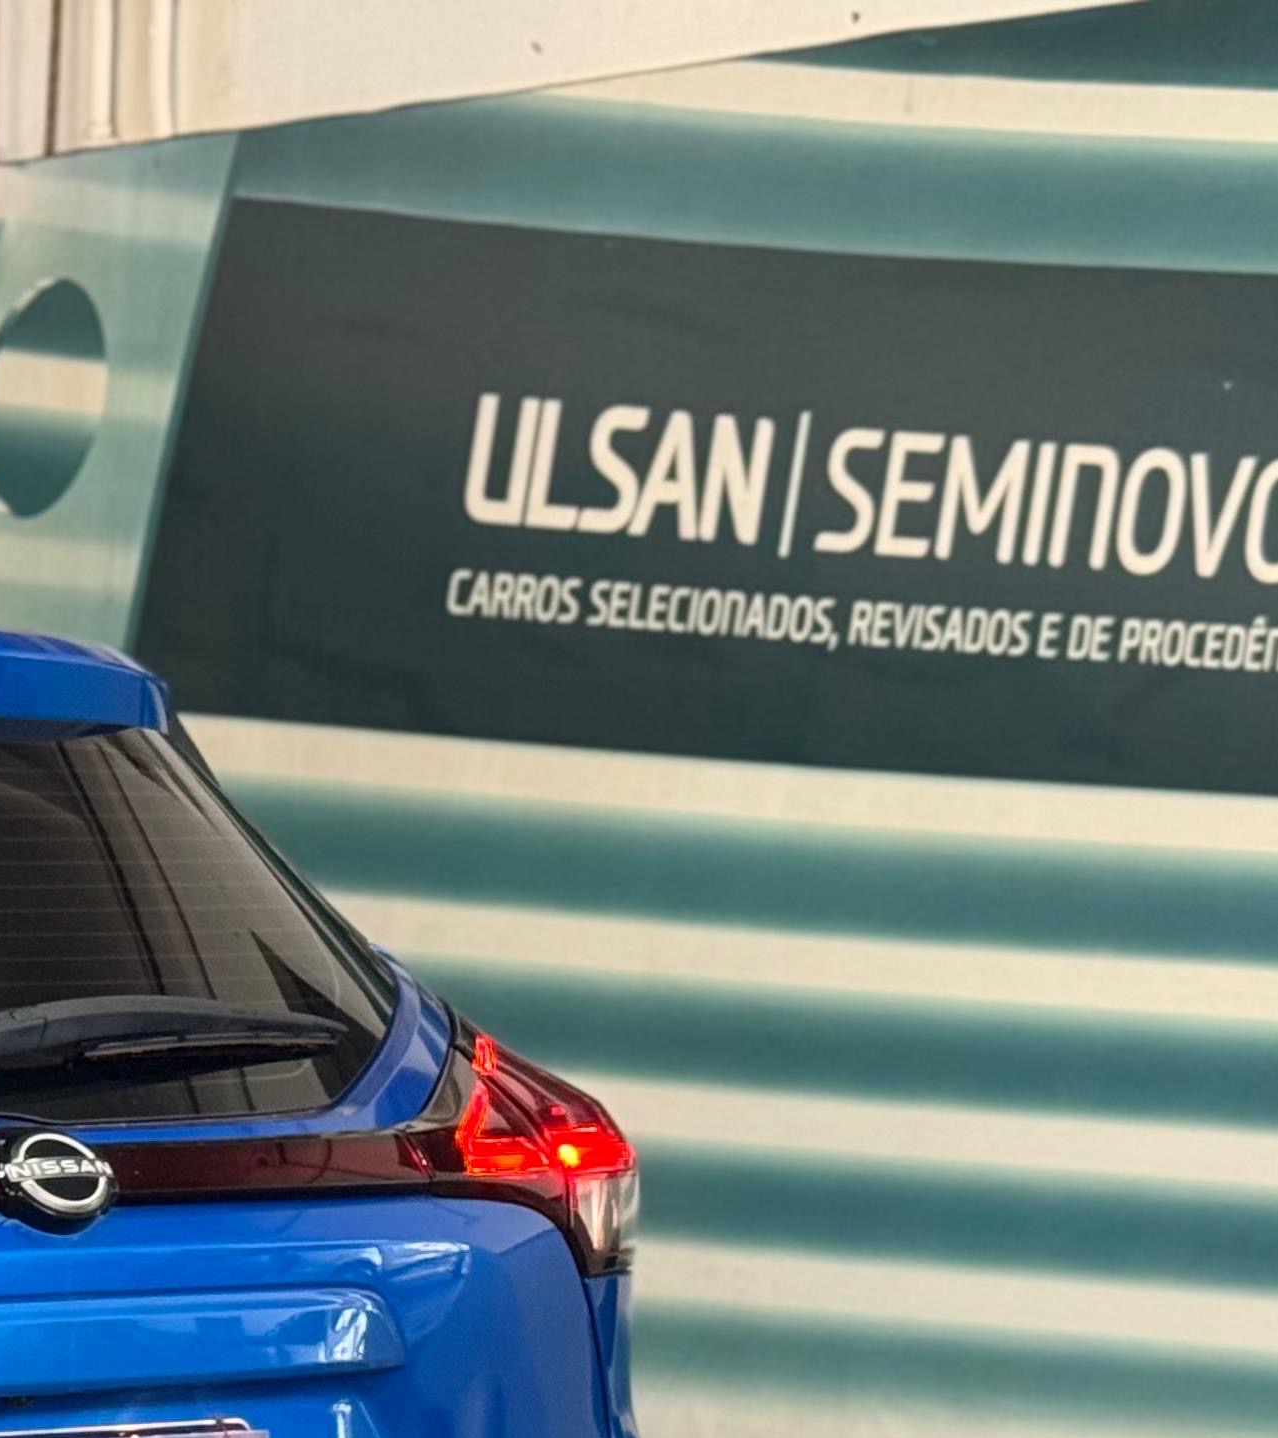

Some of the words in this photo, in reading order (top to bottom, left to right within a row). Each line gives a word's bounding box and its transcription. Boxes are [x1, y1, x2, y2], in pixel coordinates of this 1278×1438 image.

[464, 392, 776, 546] ULSAN
[447, 568, 582, 624] CARROS
[586, 579, 839, 650] SELECIONADOS,
[847, 599, 1034, 657] REVISADOS
[1036, 611, 1063, 659] E
[1066, 613, 1115, 662] DE
[8, 1157, 114, 1180] NISSAN
